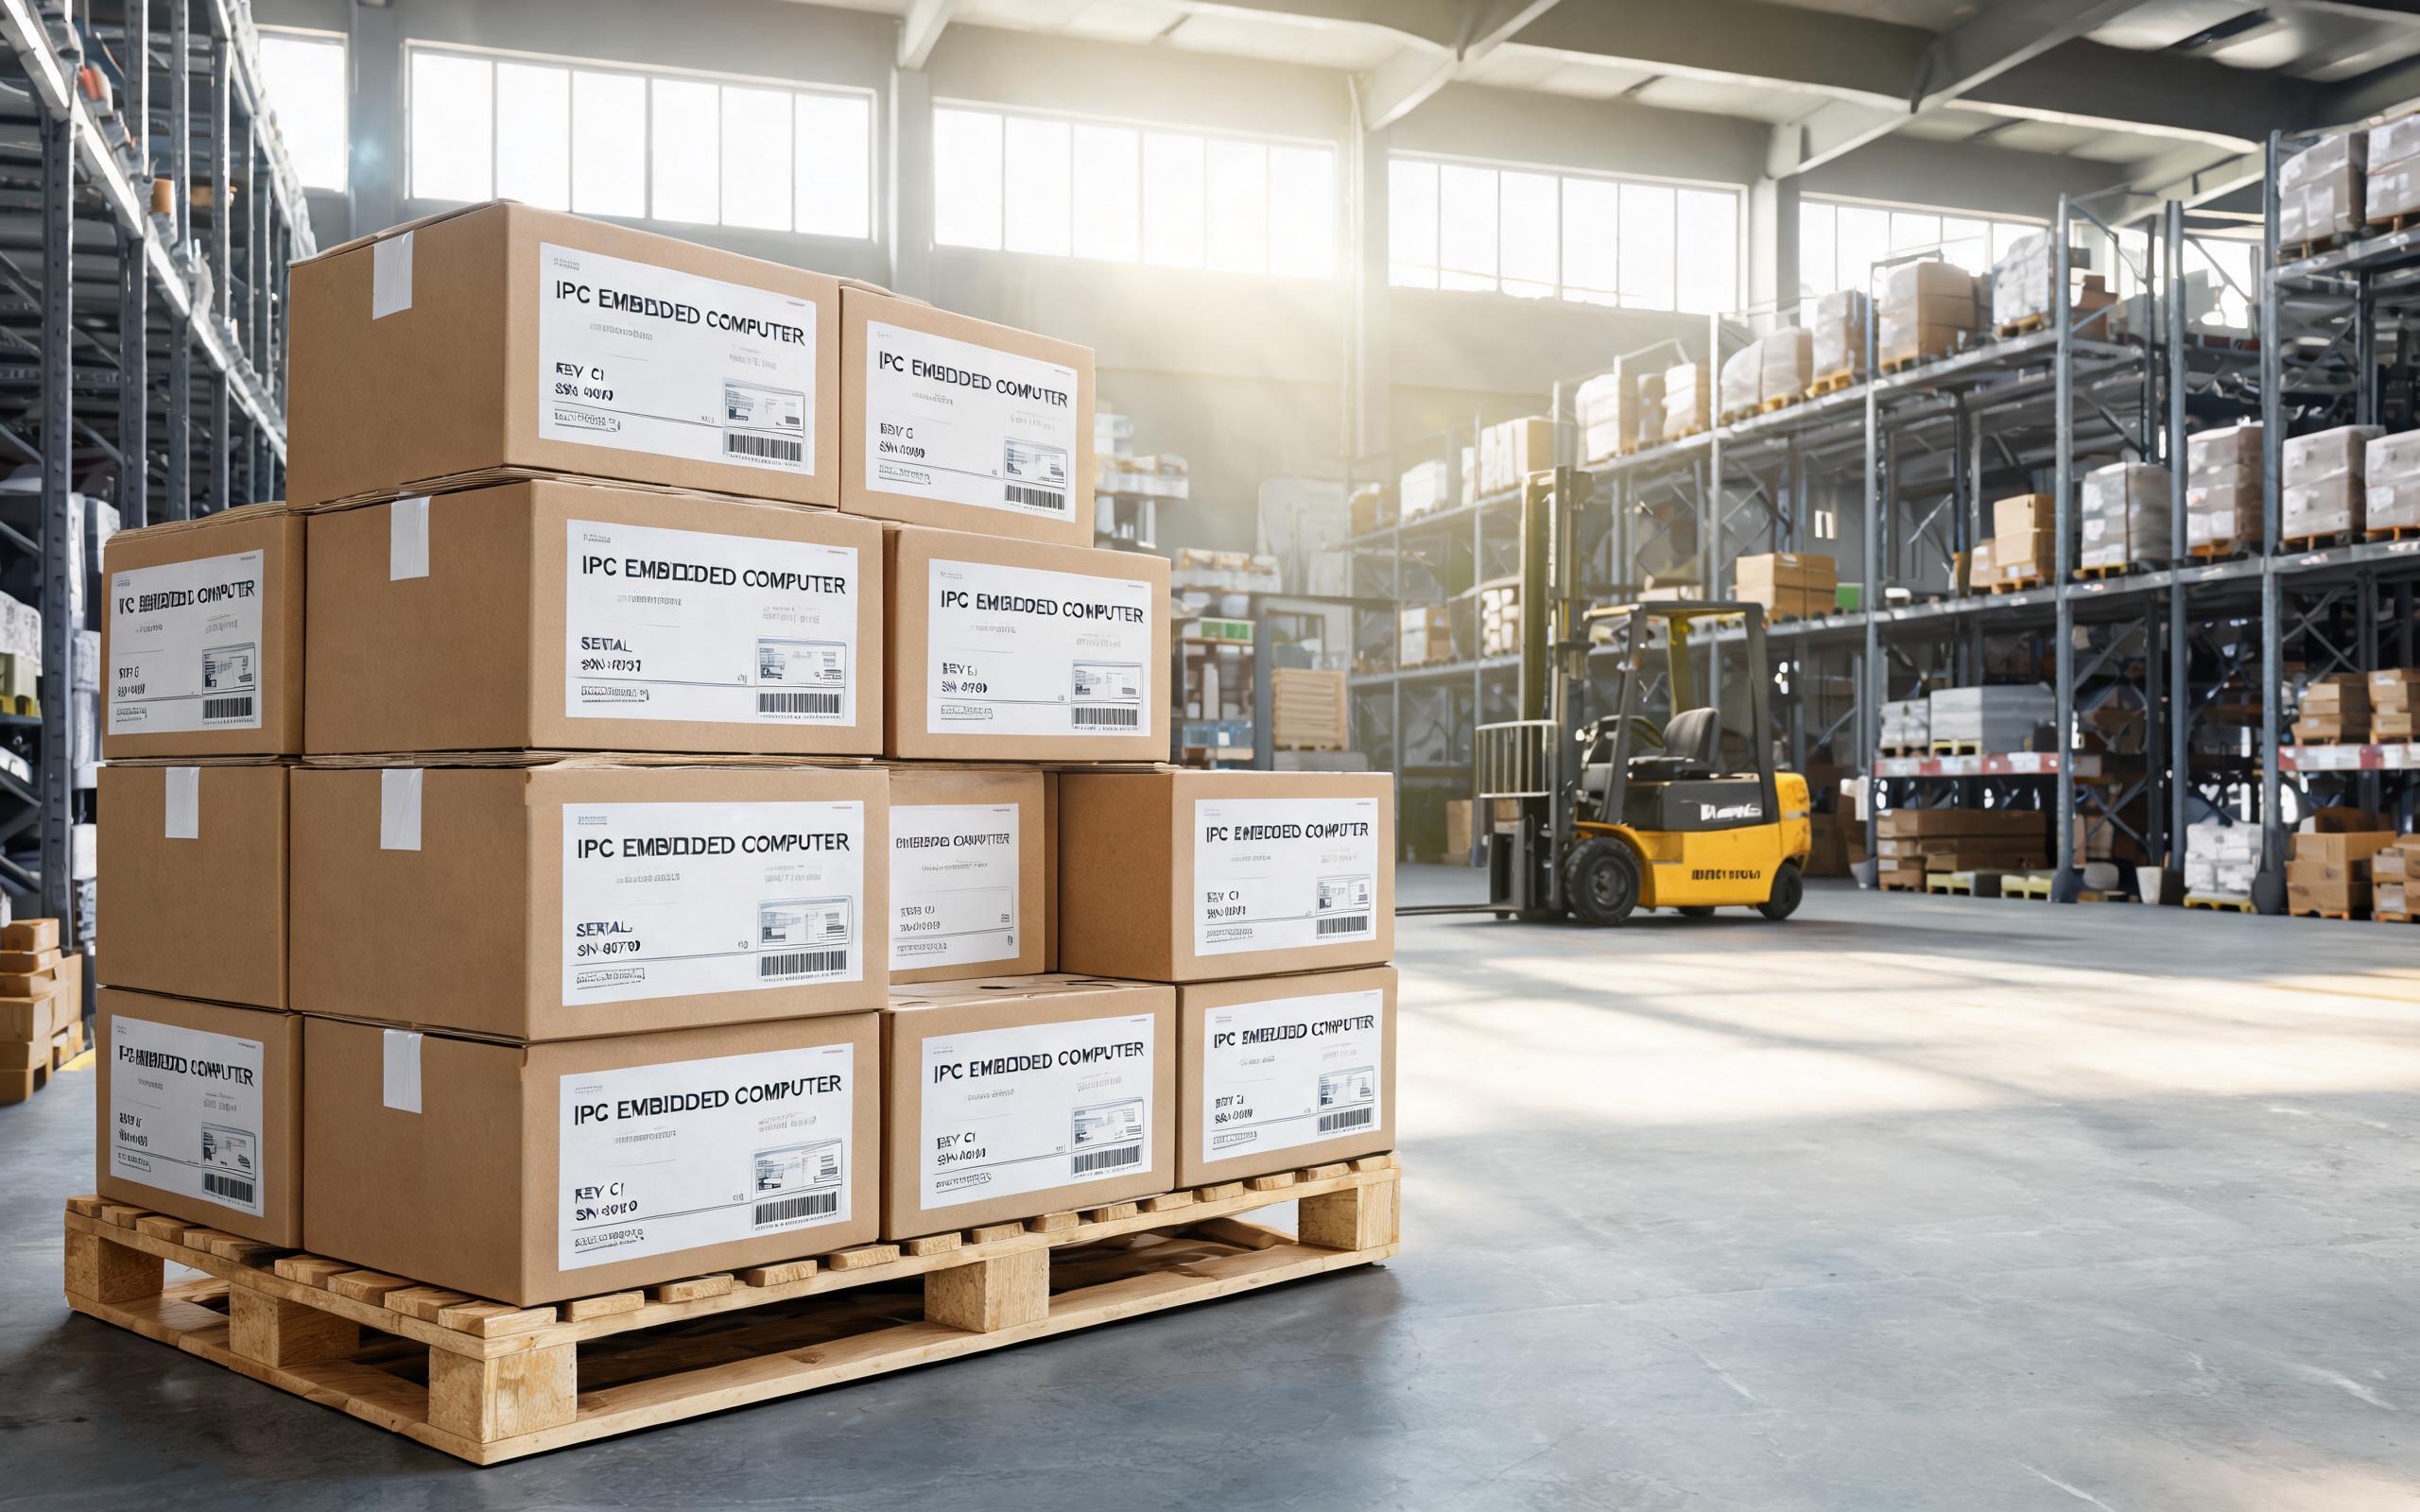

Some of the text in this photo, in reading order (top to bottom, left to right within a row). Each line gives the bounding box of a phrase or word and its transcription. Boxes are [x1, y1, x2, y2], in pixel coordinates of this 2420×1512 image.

[556, 280, 591, 303] IPC
[706, 310, 806, 347] COMPUTER
[879, 351, 905, 372] IPC
[581, 555, 617, 576] IPC
[742, 569, 846, 594] COMPUTER
[941, 590, 969, 608] IPC
[577, 838, 615, 858] IPC
[741, 833, 850, 852] COMPUTER
[1206, 826, 1228, 843] IPC
[1214, 1032, 1236, 1049] IPC
[934, 1063, 963, 1084] IPC
[1058, 1041, 1145, 1066] COMPUTER
[574, 1103, 609, 1125] IPC
[735, 1074, 842, 1105] COMPUTER
